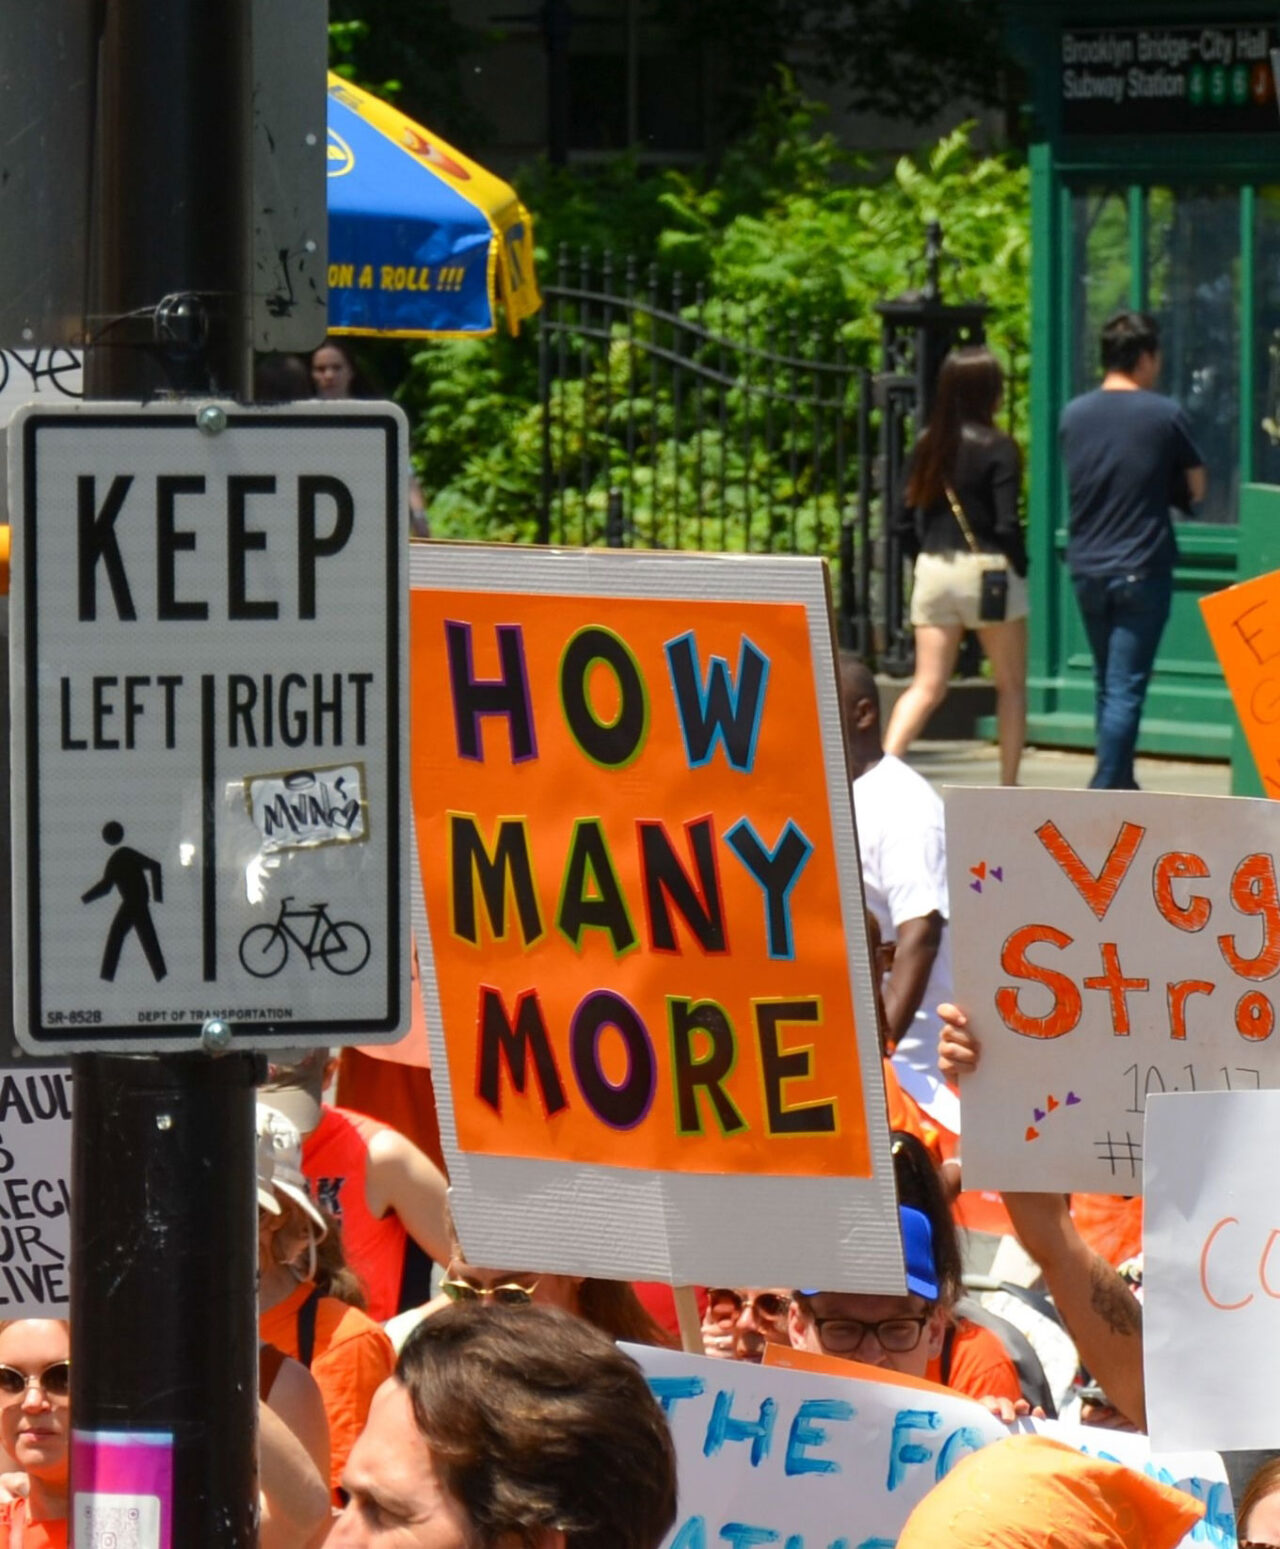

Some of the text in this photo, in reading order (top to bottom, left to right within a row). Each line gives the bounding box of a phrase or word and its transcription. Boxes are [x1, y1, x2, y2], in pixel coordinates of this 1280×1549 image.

[1063, 33, 1134, 67] Brooklyn
[1236, 29, 1268, 58] Hall
[1063, 69, 1125, 103] Subway
[1128, 67, 1186, 98] Station
[328, 265, 354, 288] ON
[358, 265, 373, 288] A
[380, 265, 430, 291] ROLL
[76, 474, 356, 623] KEEP
[60, 675, 183, 751] LEFT
[227, 673, 374, 748] RIGHT
[444, 619, 770, 773] HOW
[445, 810, 814, 960] MANY
[138, 1007, 293, 1022] DEPT OF TRANSPORTATION
[474, 984, 838, 1138] MORE
[645, 1375, 858, 1477] THE
